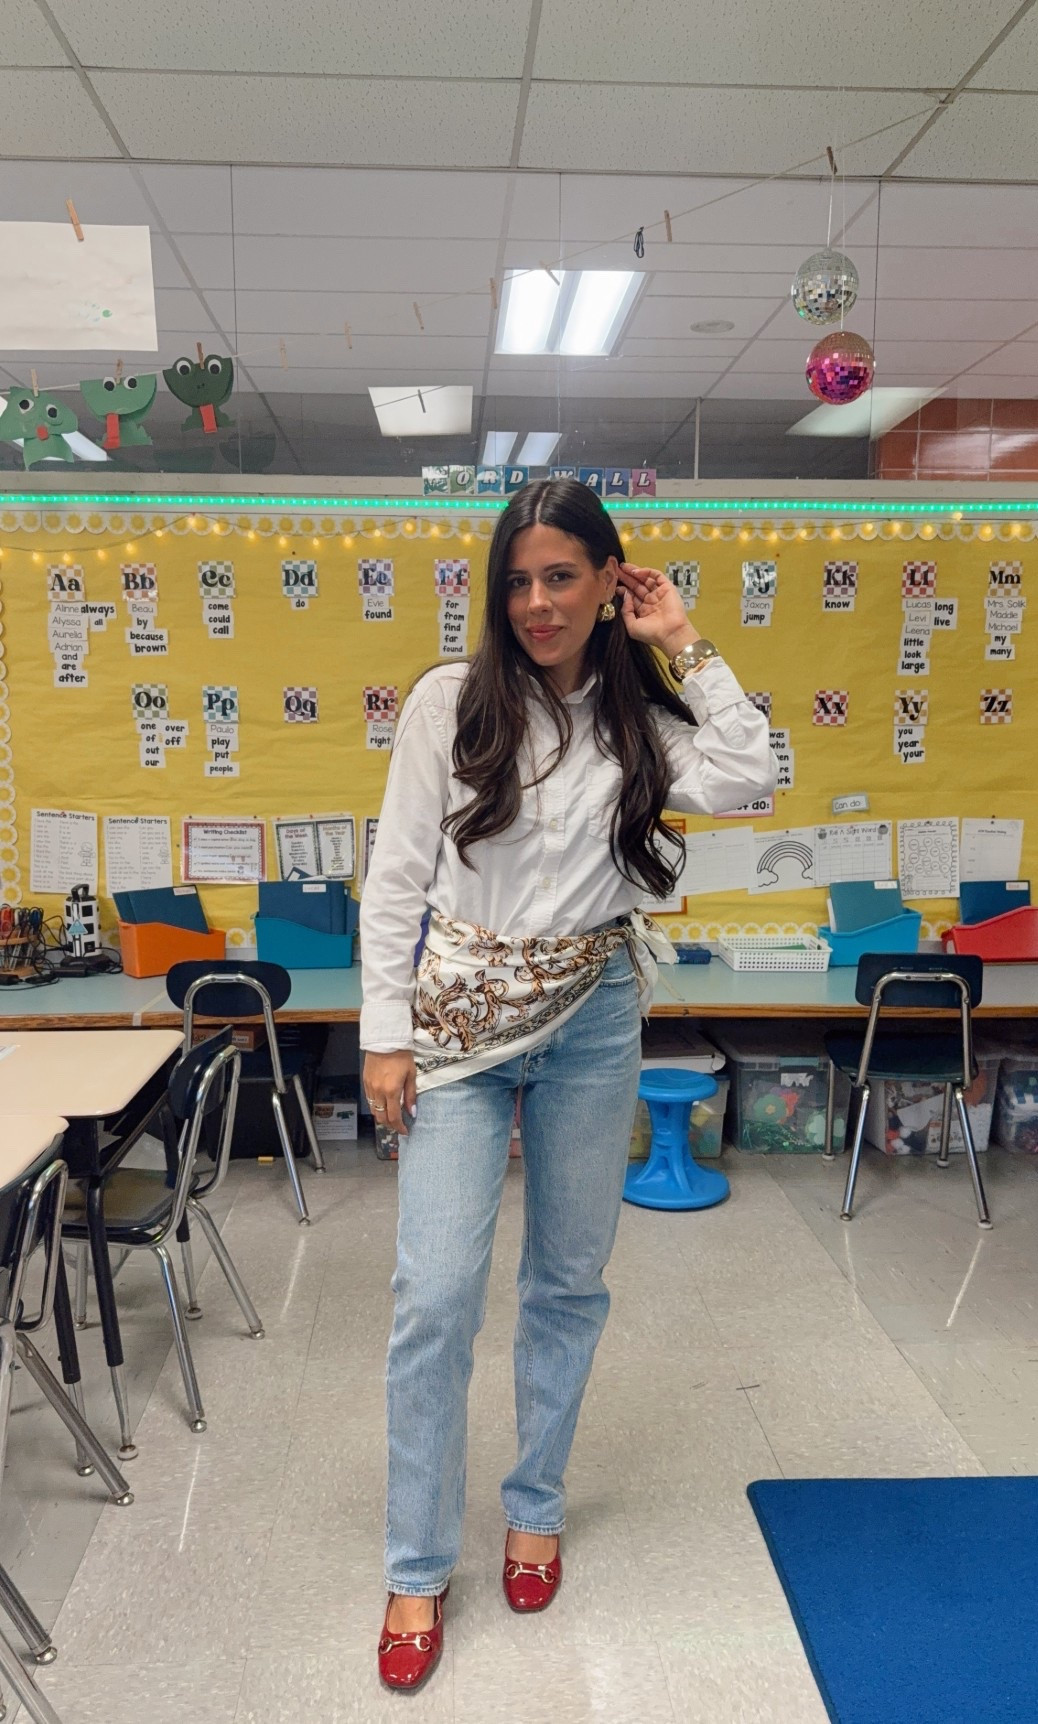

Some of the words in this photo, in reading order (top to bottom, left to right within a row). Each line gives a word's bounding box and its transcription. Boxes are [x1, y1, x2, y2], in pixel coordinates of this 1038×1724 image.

[202, 570, 231, 587] Cc
[283, 568, 314, 586] Dd
[363, 568, 388, 585] Ee
[439, 568, 467, 585] Ff
[826, 569, 855, 586] Kk
[909, 569, 929, 586] Ll
[989, 571, 1020, 585] Mm
[51, 574, 80, 591] Aa
[123, 573, 155, 590] Bb
[208, 603, 229, 611] come
[296, 599, 305, 608] do
[367, 599, 384, 608] Evie
[446, 601, 459, 609] for
[744, 600, 770, 609] Jaxon
[825, 600, 850, 609] know
[935, 602, 954, 614] long
[81, 604, 114, 617] always
[132, 604, 154, 613] Beau
[208, 615, 230, 623] could
[365, 610, 391, 619] found
[444, 612, 464, 621] from
[744, 612, 765, 624] jump
[909, 614, 926, 622] Levi
[990, 611, 1017, 619] Maddie
[52, 617, 81, 626] Alyssa
[137, 618, 148, 629] by
[934, 617, 950, 626] live
[213, 625, 229, 634] call
[444, 623, 461, 632] find
[905, 627, 930, 635] Leena
[988, 623, 1018, 631] Michael
[52, 630, 82, 638] Aurelia
[130, 632, 163, 641] because
[444, 635, 458, 643] far
[904, 638, 924, 646] little
[995, 635, 1006, 644] my
[54, 643, 83, 651] Adrian
[135, 643, 167, 653] brown
[443, 645, 463, 653] found
[990, 647, 1011, 658] many
[901, 661, 925, 673] large
[59, 674, 85, 682] after
[135, 691, 166, 708] Oo
[367, 694, 394, 711] Rr
[983, 696, 1009, 712] Zz
[207, 693, 234, 716] Pp
[285, 695, 316, 718] Qq
[817, 697, 845, 714] Xx
[899, 697, 924, 720] Yy
[372, 725, 392, 733] Rose
[898, 728, 912, 738] you
[146, 734, 156, 742] of
[165, 737, 181, 745] off
[370, 737, 390, 748] right
[212, 738, 230, 748] play
[898, 741, 919, 752] year
[215, 751, 229, 761] put
[903, 750, 924, 762] your
[210, 765, 233, 774] people
[834, 802, 848, 810] Can
[850, 800, 861, 808] do
[69, 813, 95, 821] Starters
